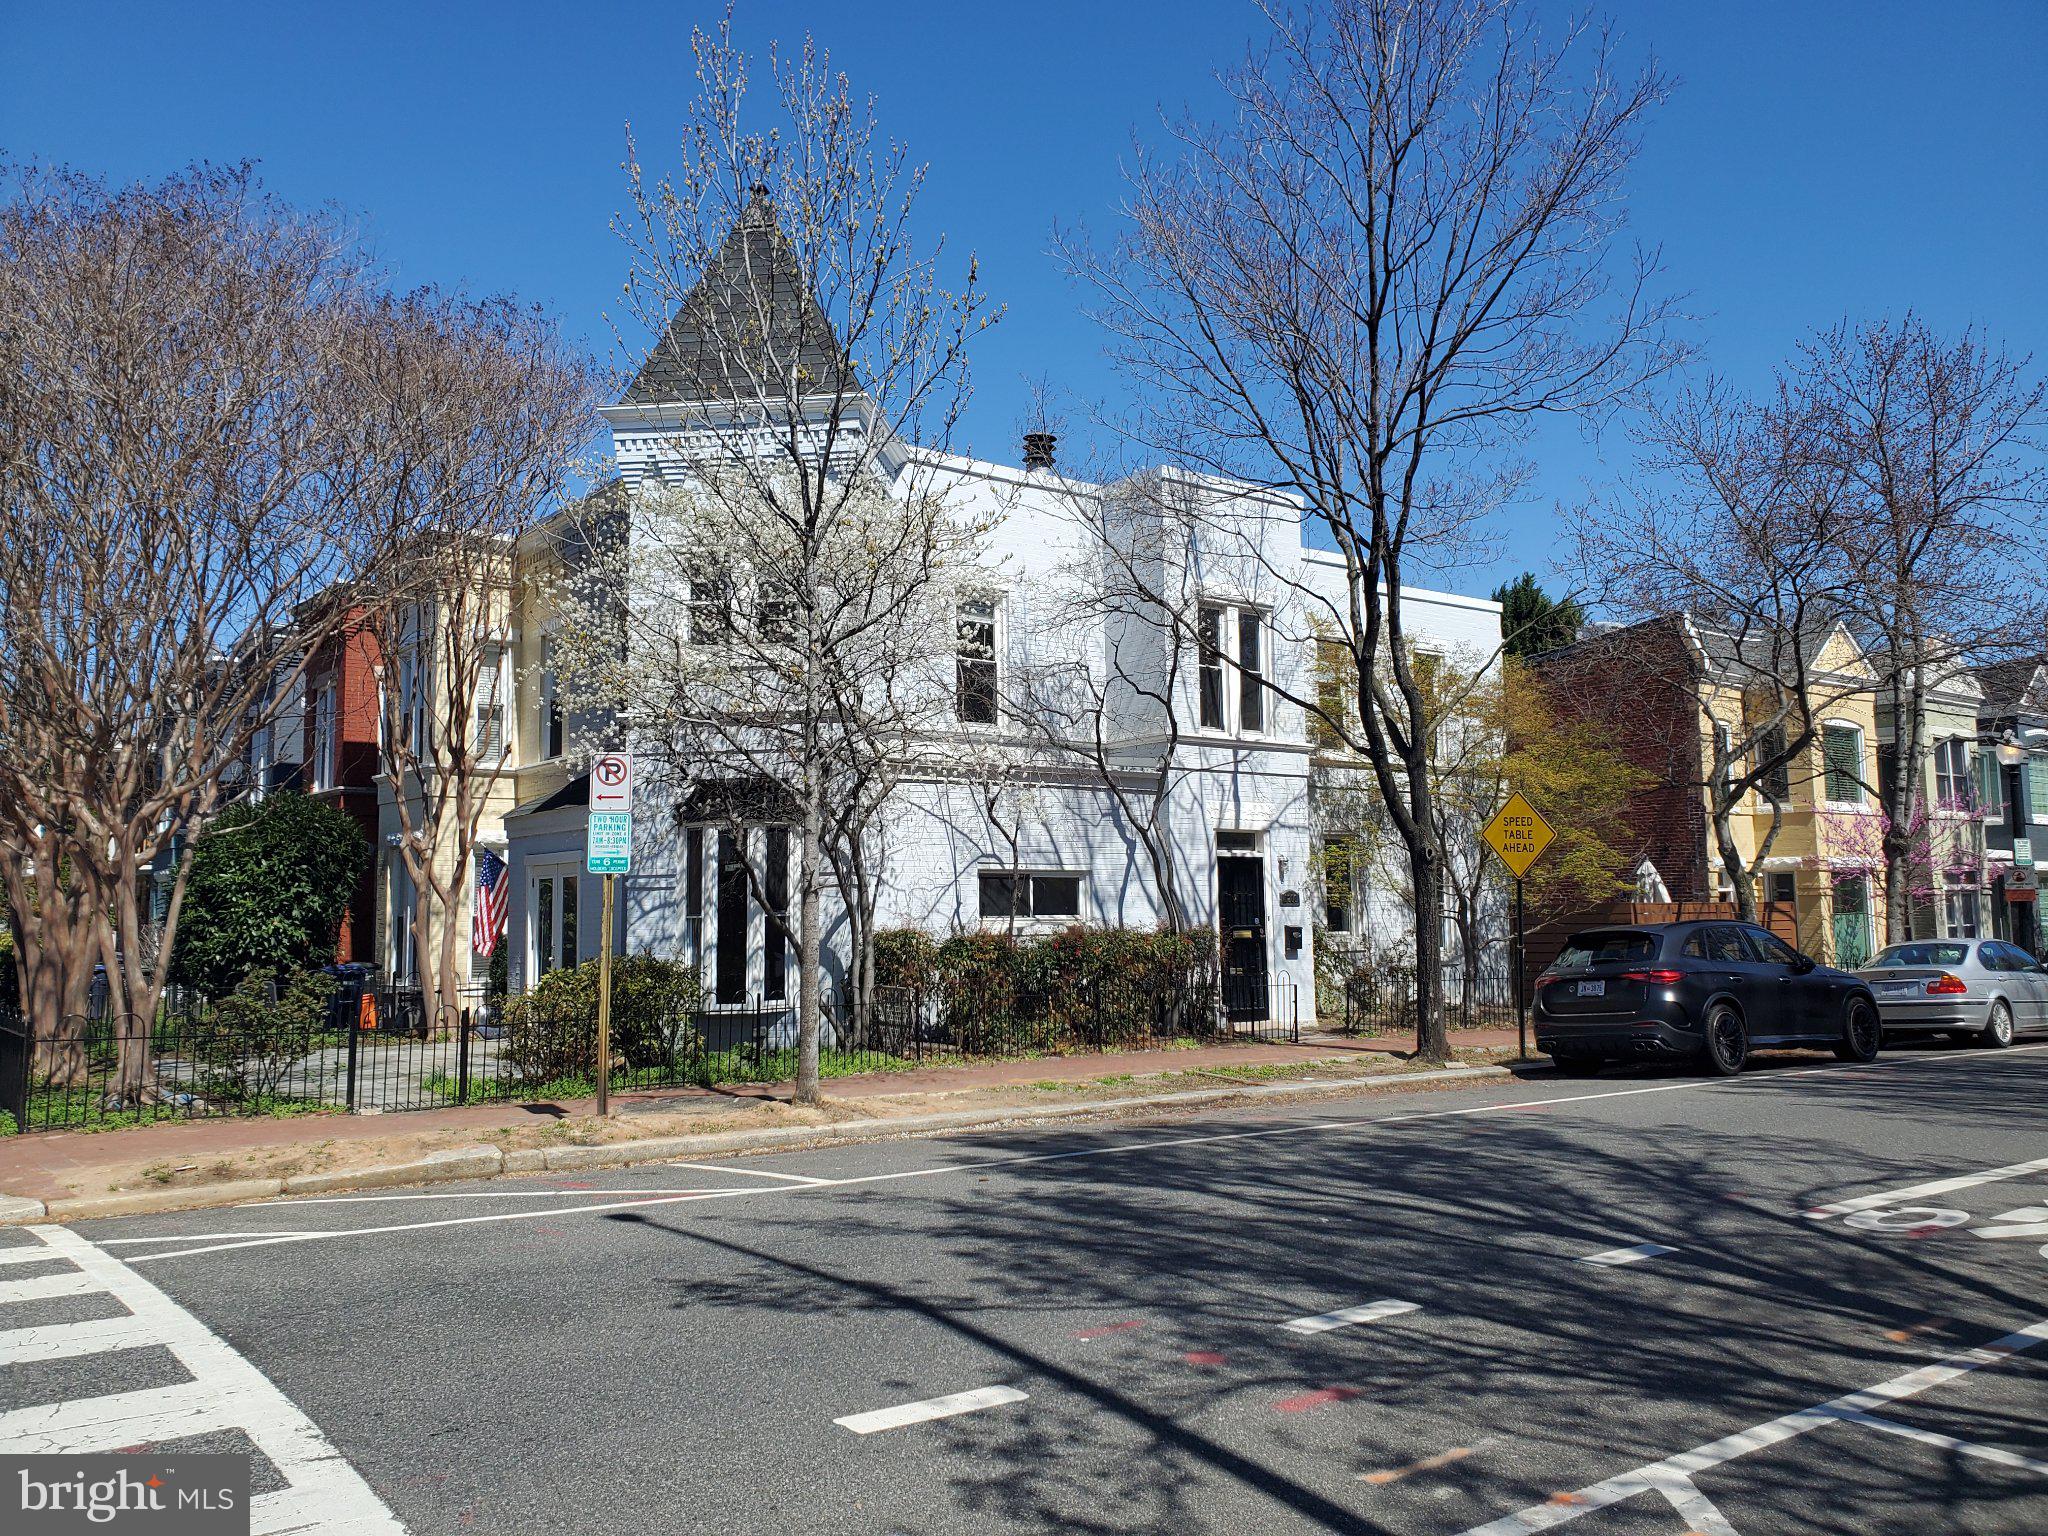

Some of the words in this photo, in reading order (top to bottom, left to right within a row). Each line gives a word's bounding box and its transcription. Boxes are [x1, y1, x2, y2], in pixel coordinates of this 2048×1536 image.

[1503, 817, 1533, 826] SPEED
[1503, 830, 1533, 839] TABLE
[1502, 843, 1535, 853] AHEAD
[603, 858, 611, 866] 6
